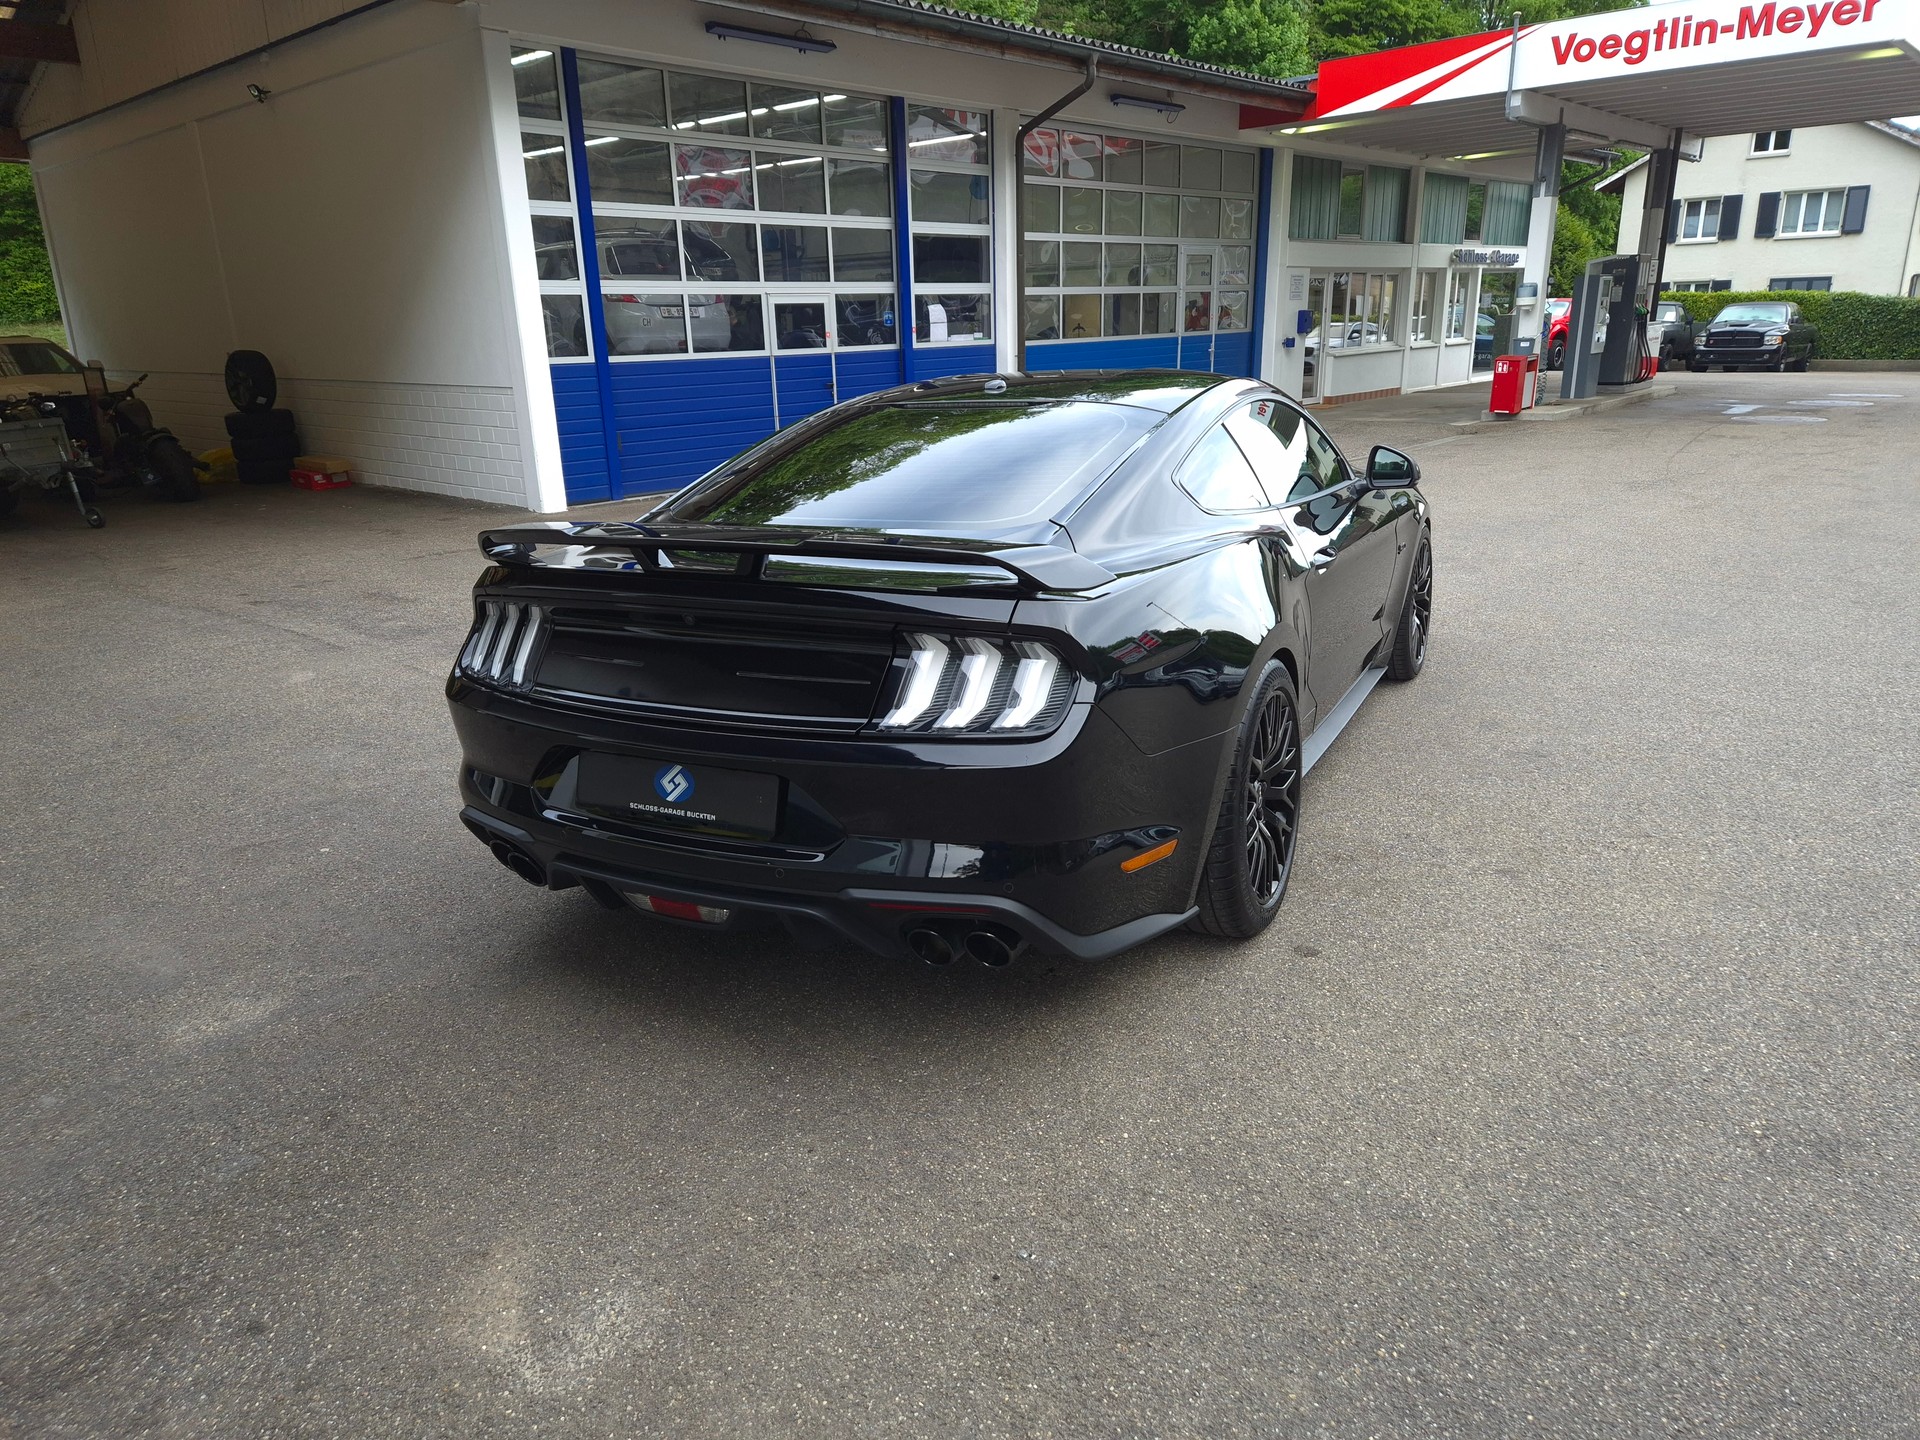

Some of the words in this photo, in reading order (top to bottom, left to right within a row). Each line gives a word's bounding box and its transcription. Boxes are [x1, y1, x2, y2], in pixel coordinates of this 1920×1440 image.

[1551, 0, 1881, 65] Voegtlin-Meyer
[629, 802, 685, 817] SCHLOSS-GARAGE
[686, 811, 716, 821] BUCKTEN
